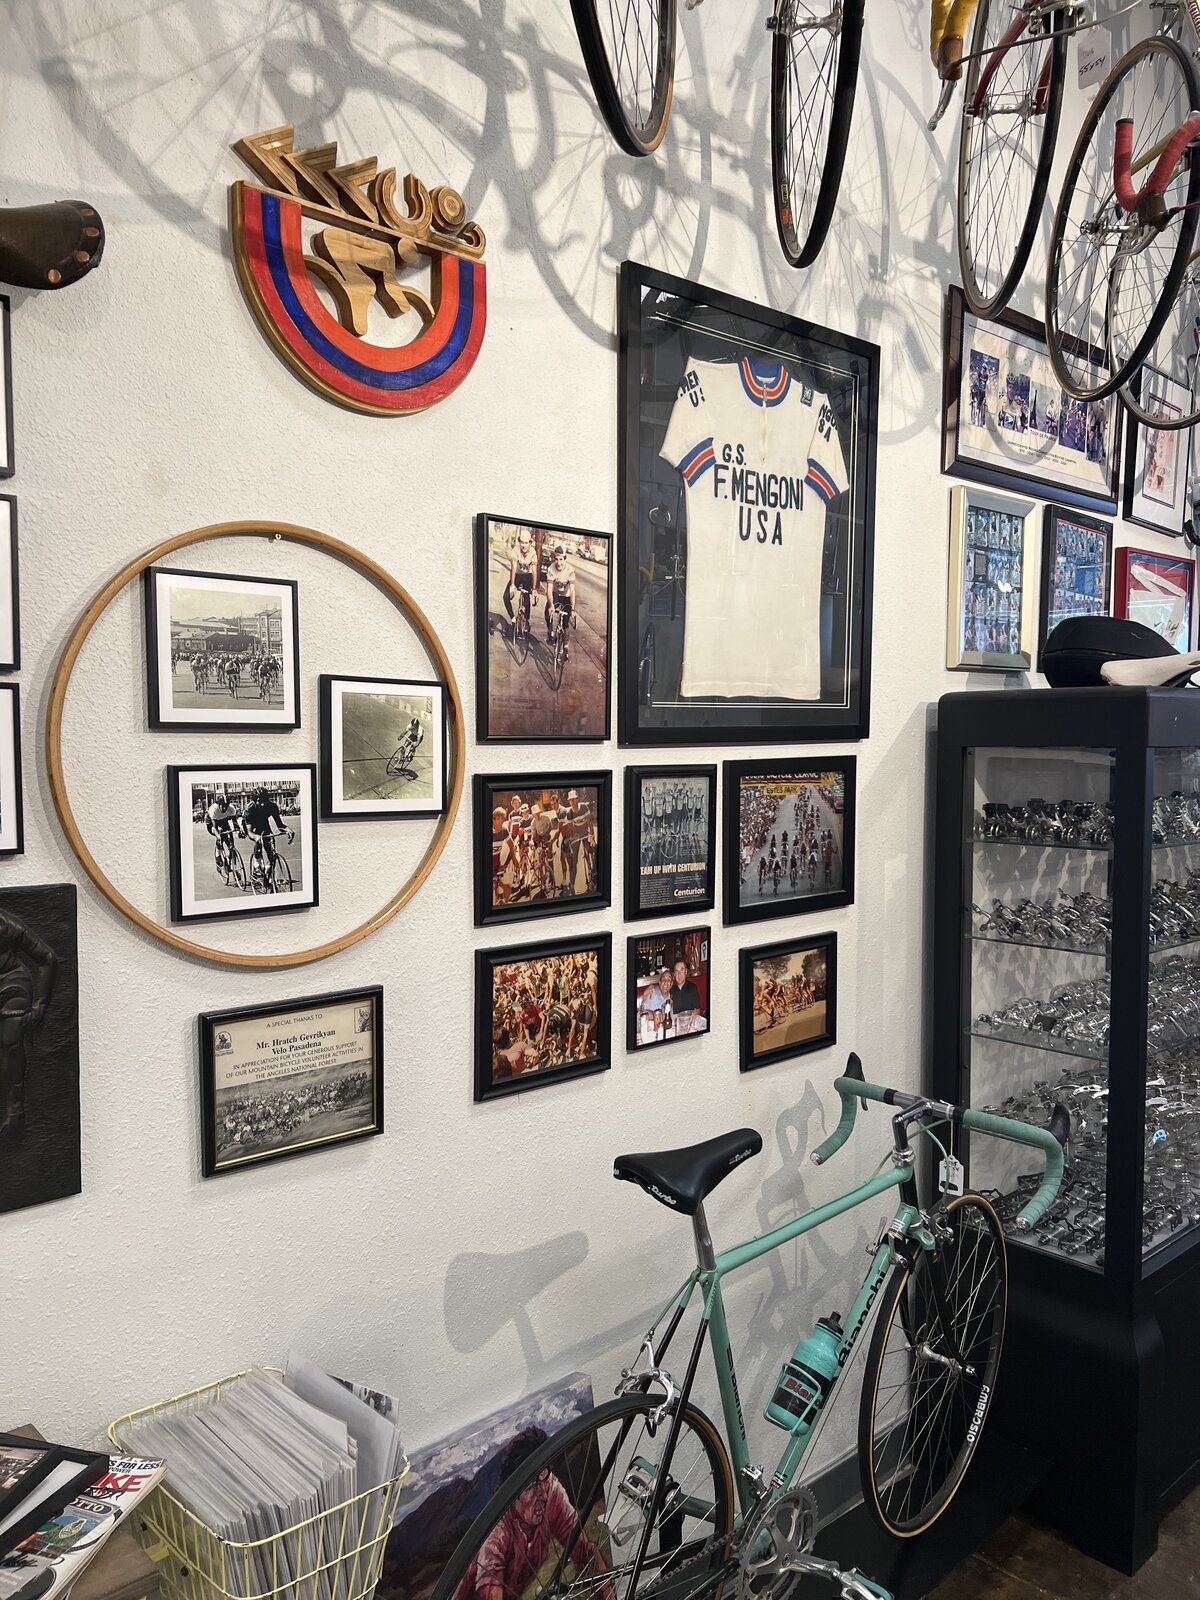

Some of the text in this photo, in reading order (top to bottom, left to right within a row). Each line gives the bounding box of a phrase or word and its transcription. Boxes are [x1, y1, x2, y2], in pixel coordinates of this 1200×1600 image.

[722, 443, 747, 466] G.S.
[738, 506, 782, 546] USA
[654, 865, 662, 874] UP
[662, 863, 677, 873] WITH
[678, 862, 706, 872] CENTURION
[674, 887, 705, 897] Centurion
[271, 1019, 292, 1027] SPECIAL
[294, 1015, 314, 1023] THANKS
[256, 1029, 336, 1050] Mr. Hratch Gevrikyan
[272, 1041, 322, 1055] Velo Pasadena
[235, 1069, 248, 1077] OUR
[248, 1063, 279, 1074] MOUNTAIN
[280, 1059, 301, 1068] BICYCLE
[301, 1053, 332, 1063] VOLUNTEER
[332, 1048, 357, 1058] ACTIVITIES
[241, 1057, 279, 1068] APPRECIATION
[291, 1050, 307, 1058] YOUR
[307, 1046, 335, 1056] GENEROUS
[335, 1041, 357, 1050] SUPPORT
[266, 1068, 291, 1077] ANGELES
[291, 1062, 317, 1072] NATIONAL
[651, 1184, 677, 1205] Turbo
[967, 1384, 990, 1442] AMBROSIO
[117, 1461, 138, 1470] FOR
[137, 1461, 161, 1470] LESS
[92, 1472, 153, 1492] IKE
